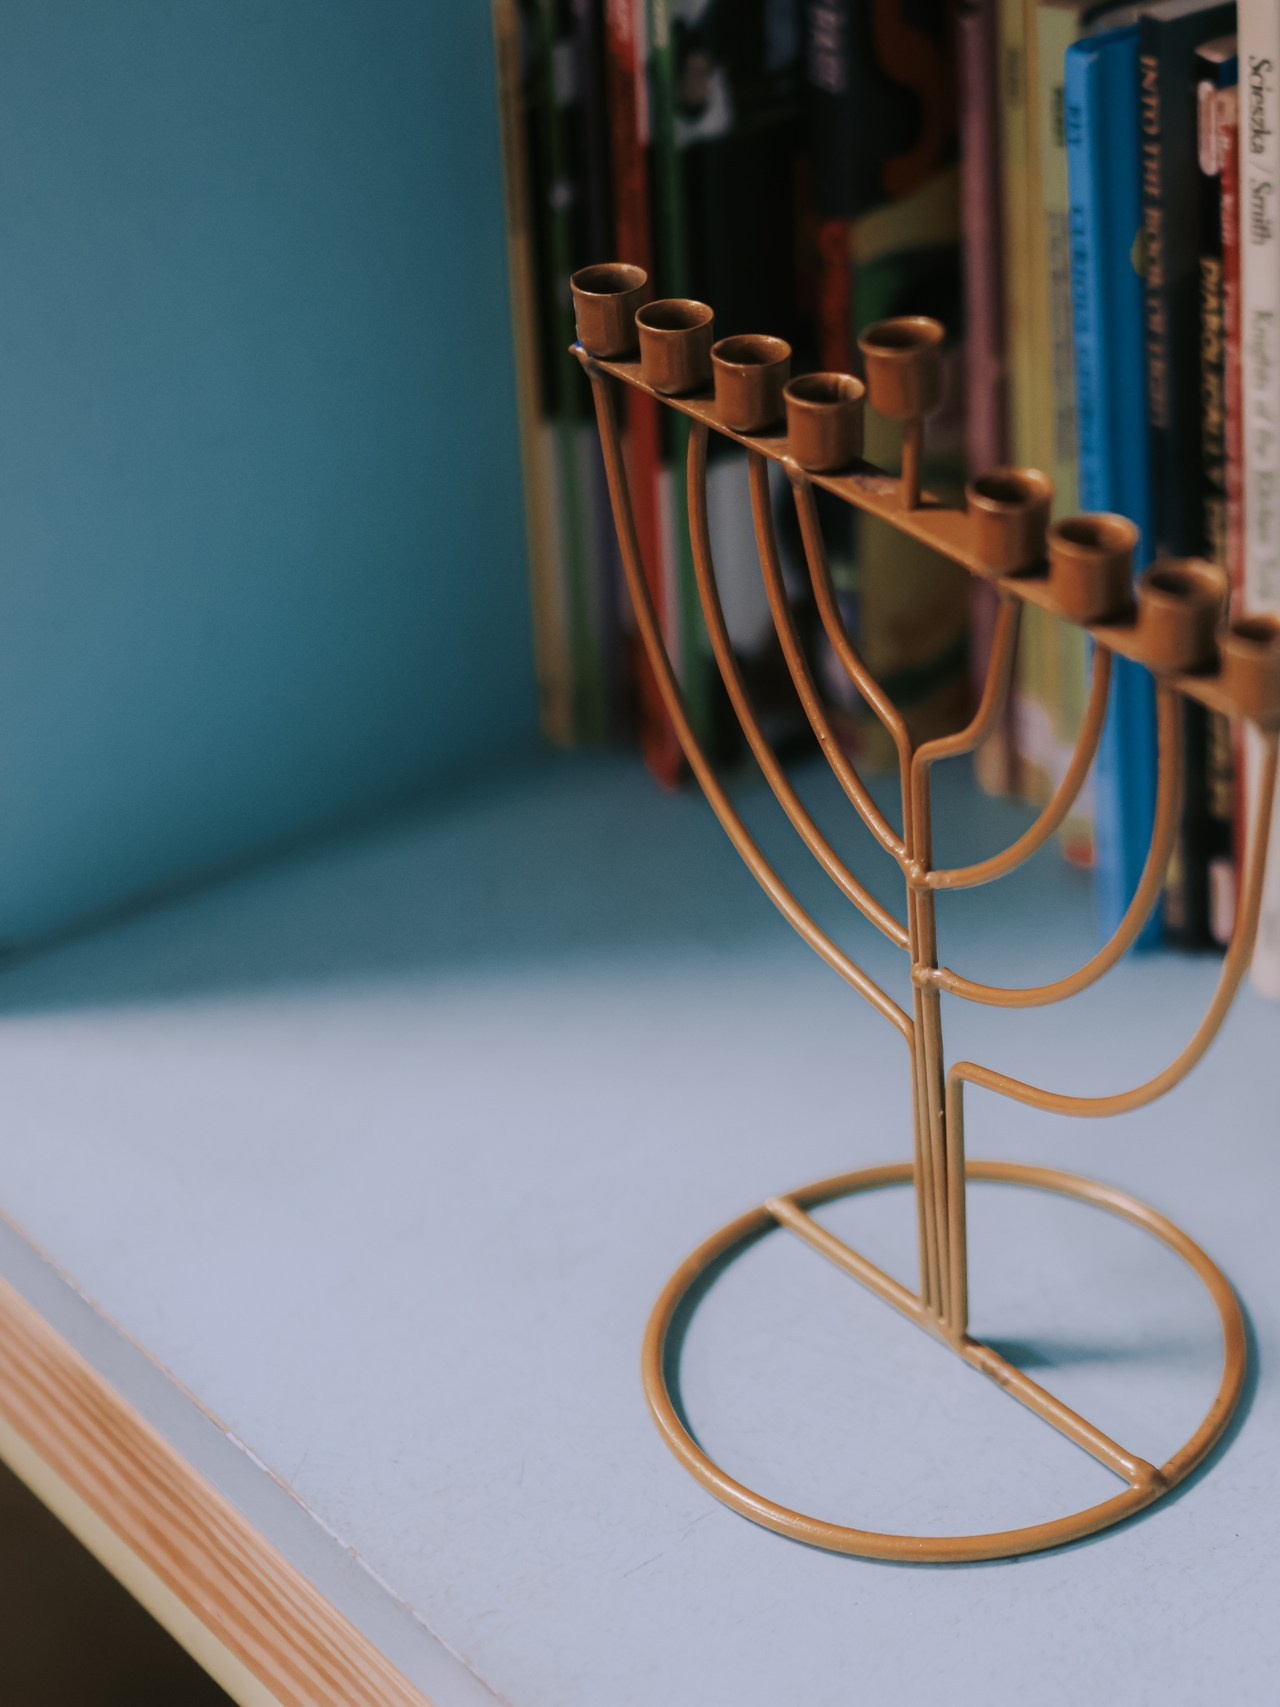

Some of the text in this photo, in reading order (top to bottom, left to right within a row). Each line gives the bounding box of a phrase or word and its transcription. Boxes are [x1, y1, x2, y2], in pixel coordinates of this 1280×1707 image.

[1140, 56, 1160, 135] INTO
[1249, 56, 1274, 154] Scieszka
[1249, 179, 1274, 246] Smith
